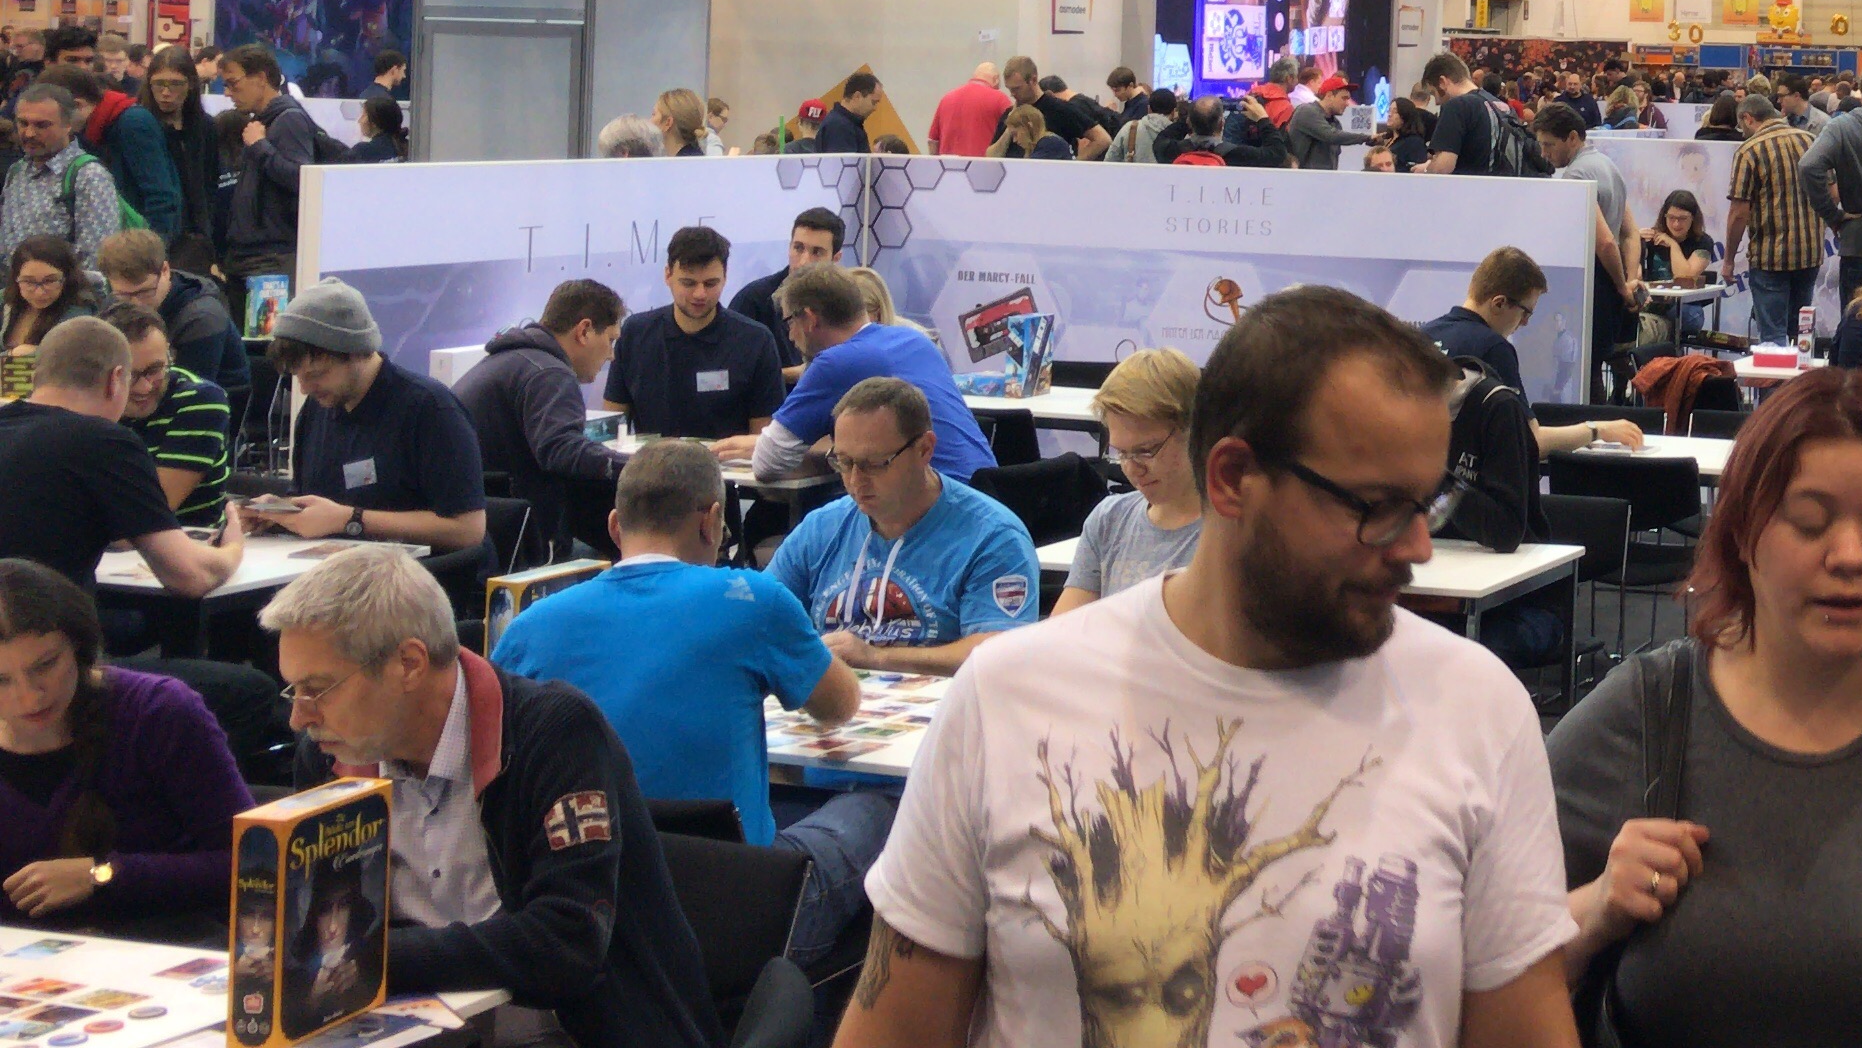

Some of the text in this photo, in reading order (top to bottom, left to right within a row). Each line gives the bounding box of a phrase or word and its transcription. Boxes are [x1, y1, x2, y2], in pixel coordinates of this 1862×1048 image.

[1058, 5, 1087, 14] asmodee
[1165, 216, 1272, 237] STORIES
[957, 270, 1037, 285] DER MARCY-FALL
[289, 811, 385, 883] Splendor
